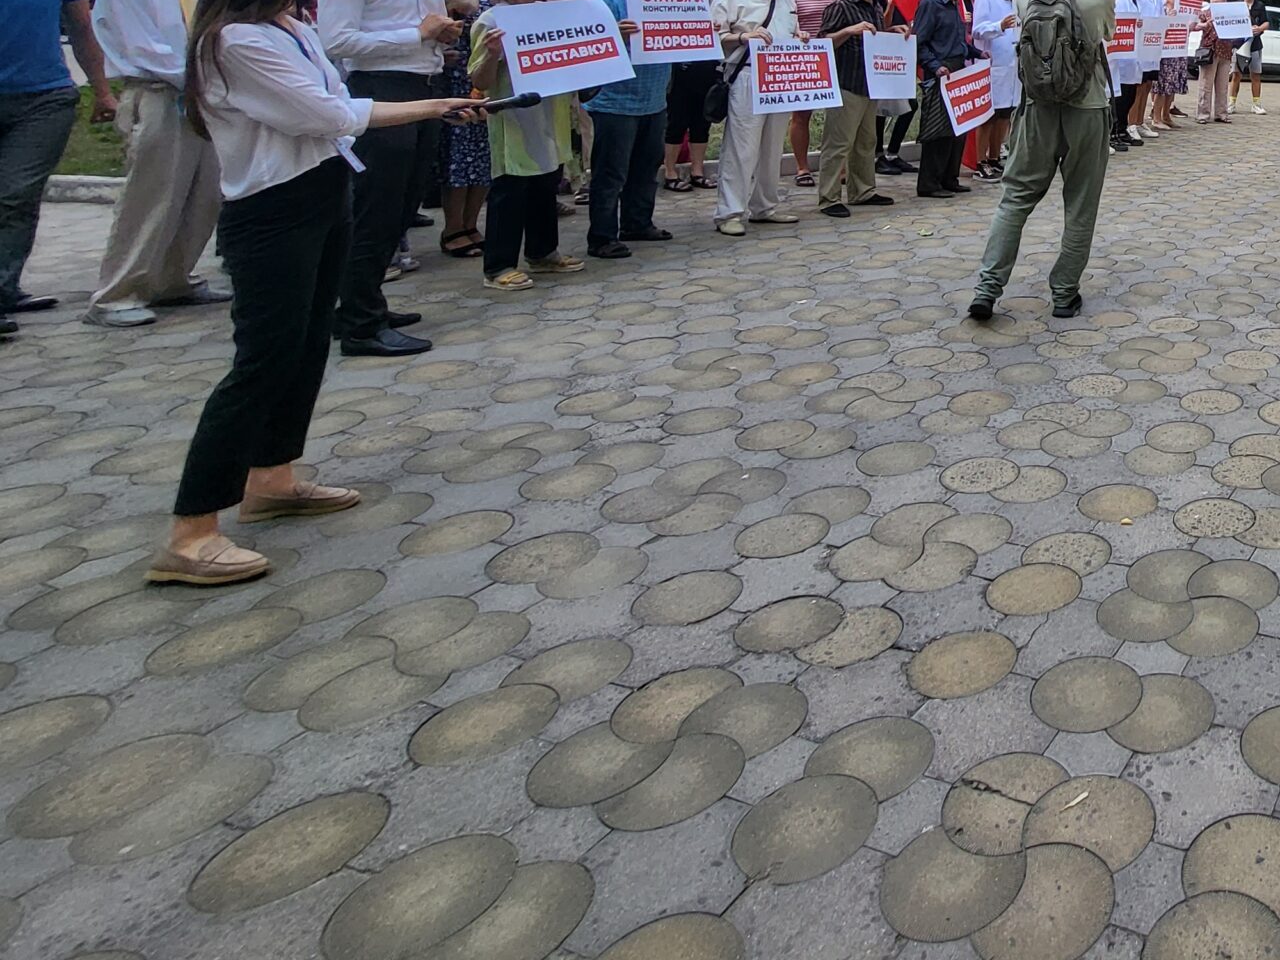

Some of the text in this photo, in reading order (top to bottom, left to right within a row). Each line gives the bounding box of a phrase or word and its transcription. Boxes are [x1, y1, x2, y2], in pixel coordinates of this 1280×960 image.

[643, 5, 696, 13] КОНСТИТУЦИИ
[671, 22, 683, 30] НА
[683, 22, 711, 30] ОХРАНУ
[1116, 24, 1134, 34] CINĂ
[516, 24, 605, 46] НЕМЕРЕНКО
[645, 35, 712, 49] ЗДОРОВЬЯ
[521, 42, 613, 68] В ОТСТАВКУ!
[766, 54, 820, 64] ÎNCĂLCAREA
[769, 62, 817, 73] EGALITĂȚII
[873, 61, 907, 71] ФАШИСТ
[765, 72, 820, 82] ÎN DREPTURI
[769, 81, 829, 93] CETĂȚENILOR
[759, 94, 784, 105] PÂNĂ
[788, 95, 801, 103] LA
[813, 92, 834, 101] ANI!
[954, 100, 973, 118] ДЛЯ
